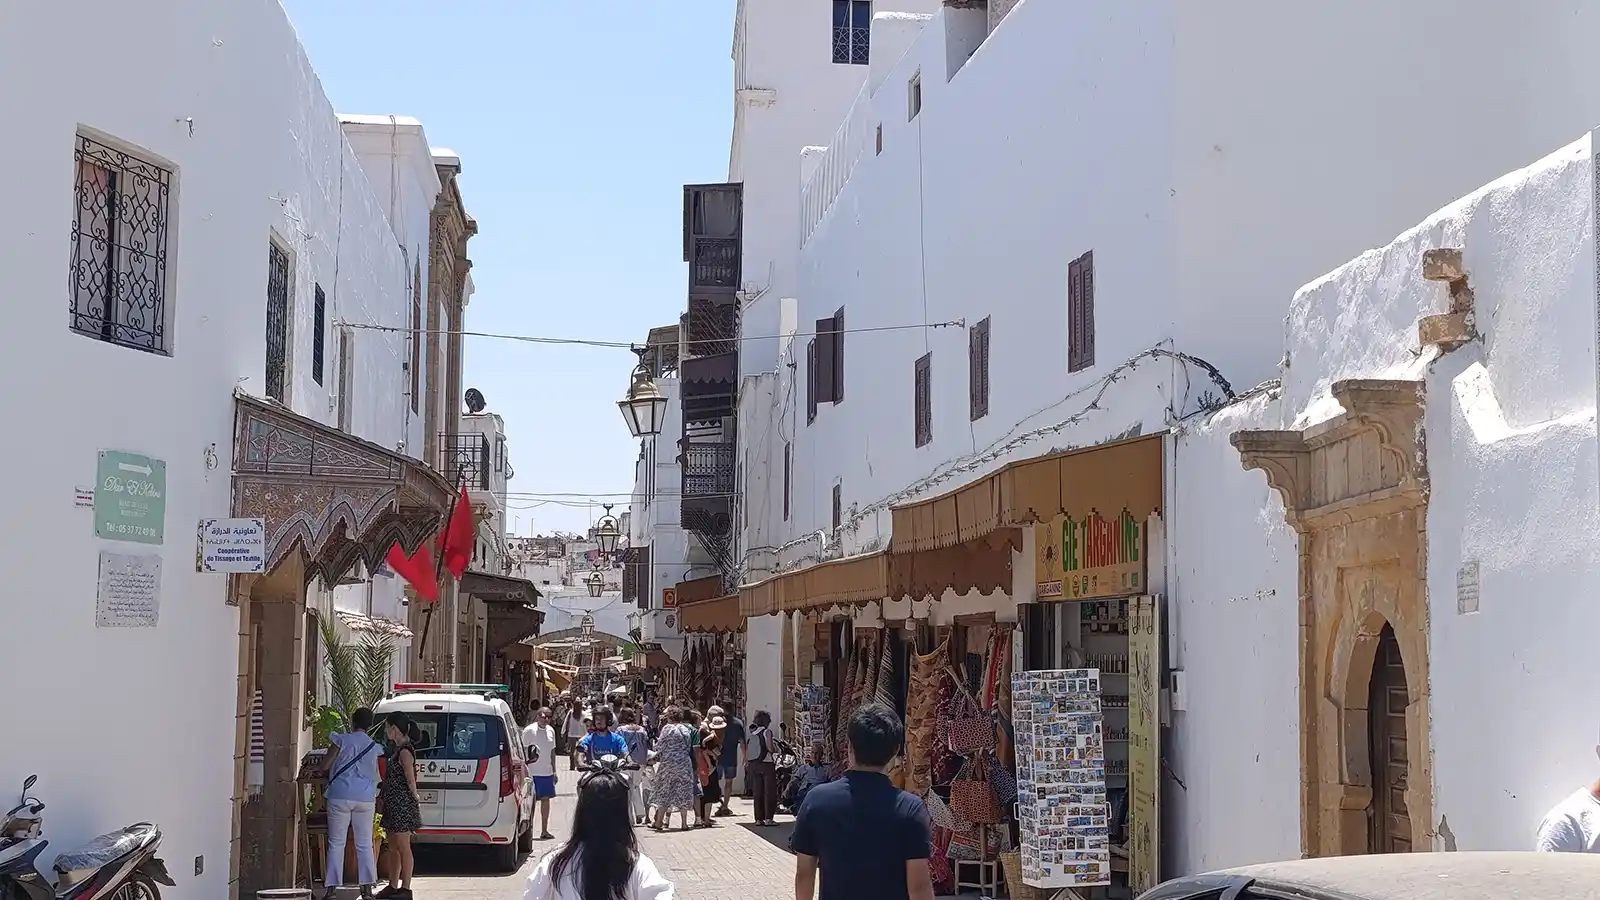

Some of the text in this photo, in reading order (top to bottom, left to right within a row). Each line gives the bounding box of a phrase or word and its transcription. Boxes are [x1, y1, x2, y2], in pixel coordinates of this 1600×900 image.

[234, 528, 256, 536] تعاونية
[1062, 512, 1139, 572] GIE TARGANINE
[440, 765, 471, 775] الشرطة
